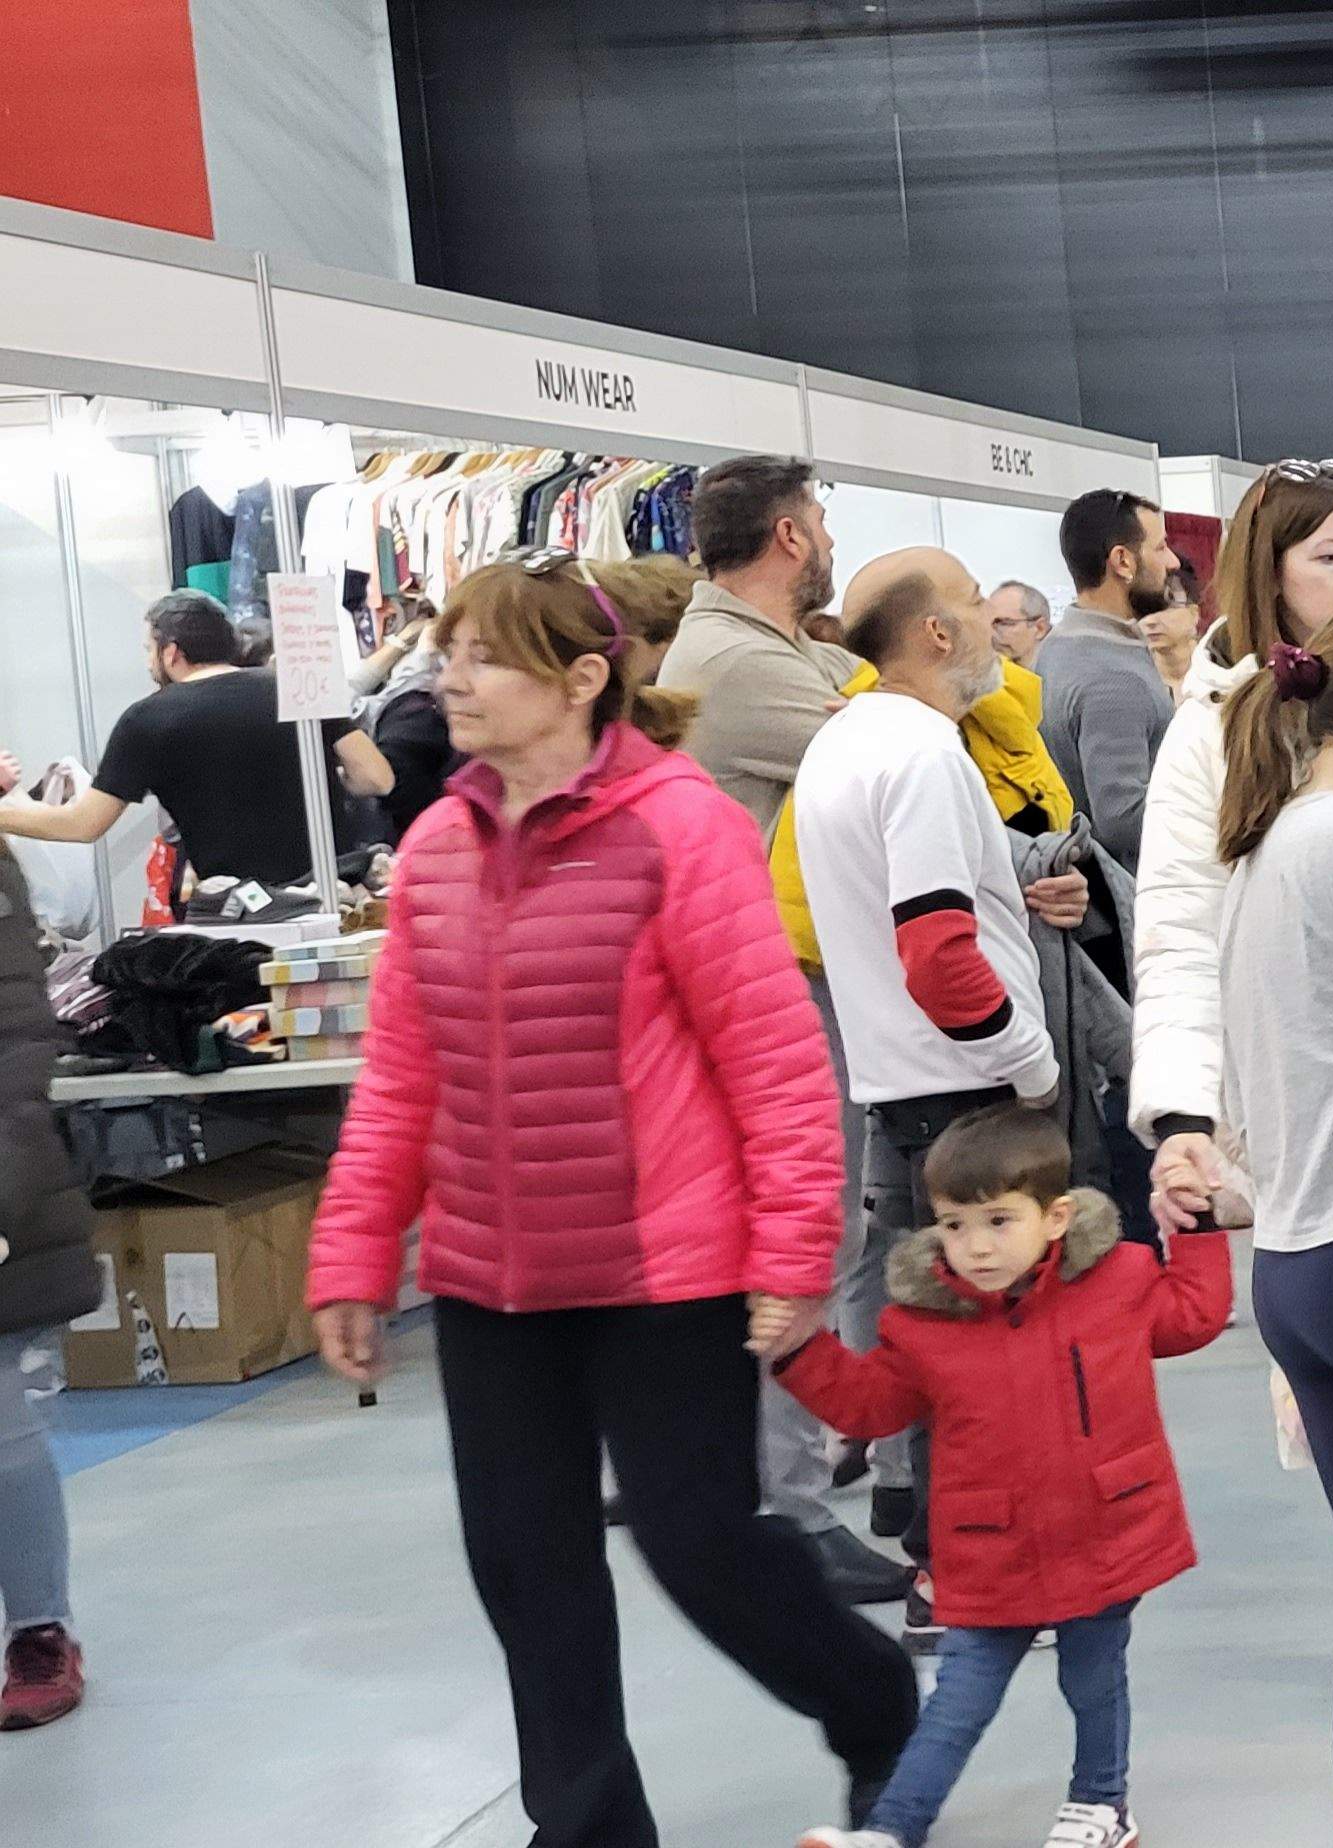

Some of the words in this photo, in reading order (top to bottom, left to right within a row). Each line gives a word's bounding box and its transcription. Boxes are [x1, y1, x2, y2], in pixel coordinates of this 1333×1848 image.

[536, 358, 579, 405] NUM
[580, 367, 637, 412] WEAR
[991, 444, 1003, 472] BE
